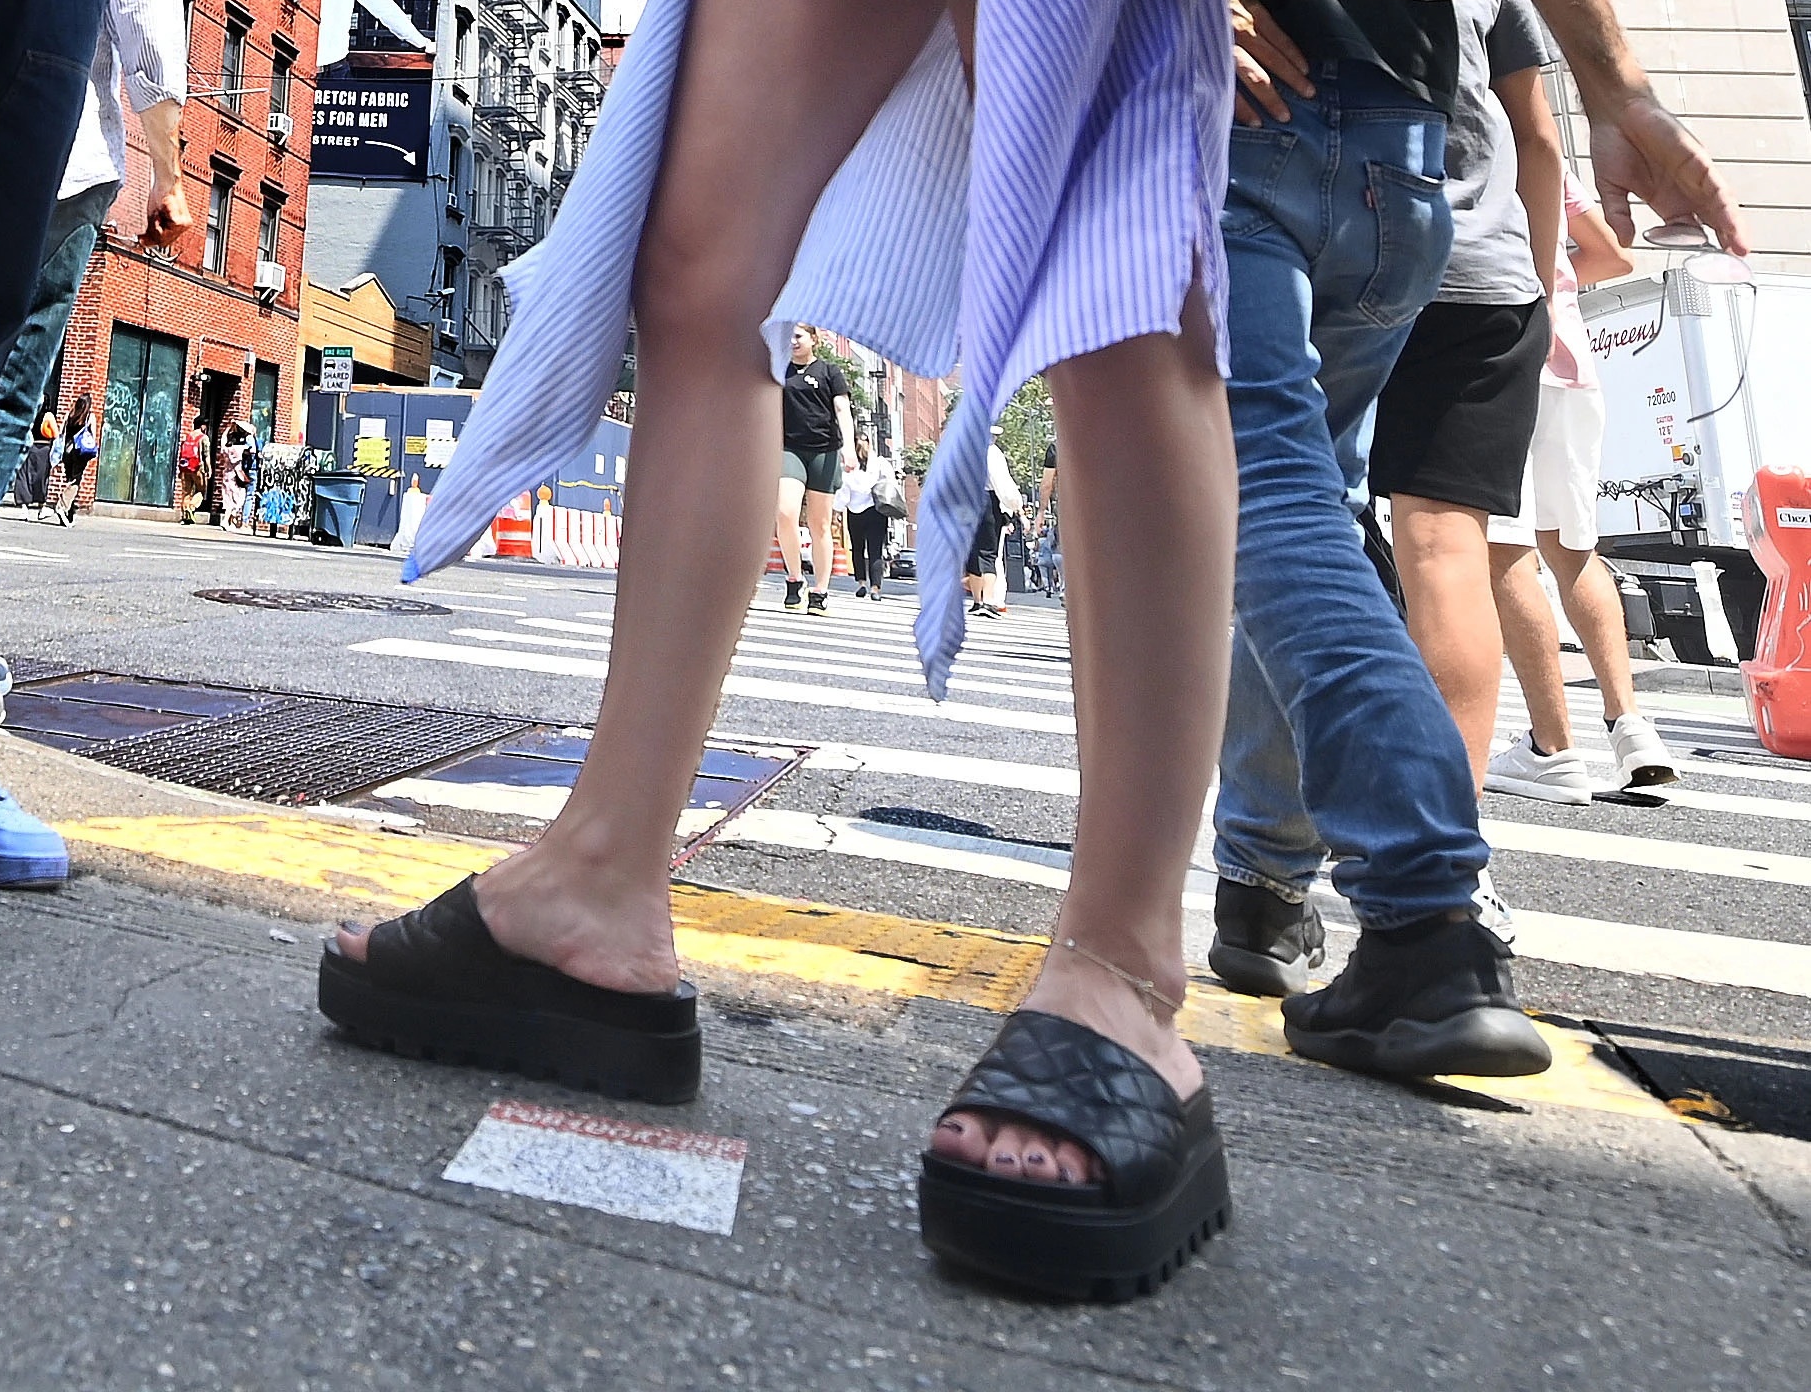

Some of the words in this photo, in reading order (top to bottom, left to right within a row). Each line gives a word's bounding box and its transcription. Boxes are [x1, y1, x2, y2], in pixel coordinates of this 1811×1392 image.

[314, 89, 357, 106] RETCH
[360, 91, 409, 108] FABRIC
[311, 110, 326, 126] ES
[329, 110, 355, 127] FOR
[358, 112, 388, 128] MEN
[312, 135, 360, 147] STREET
[1586, 319, 1658, 360] algreens
[323, 372, 350, 380] SHARED
[326, 381, 345, 389] LANE
[1646, 391, 1677, 407] 720200
[1656, 415, 1674, 424] CAUTION
[1779, 512, 1808, 523] Chez
